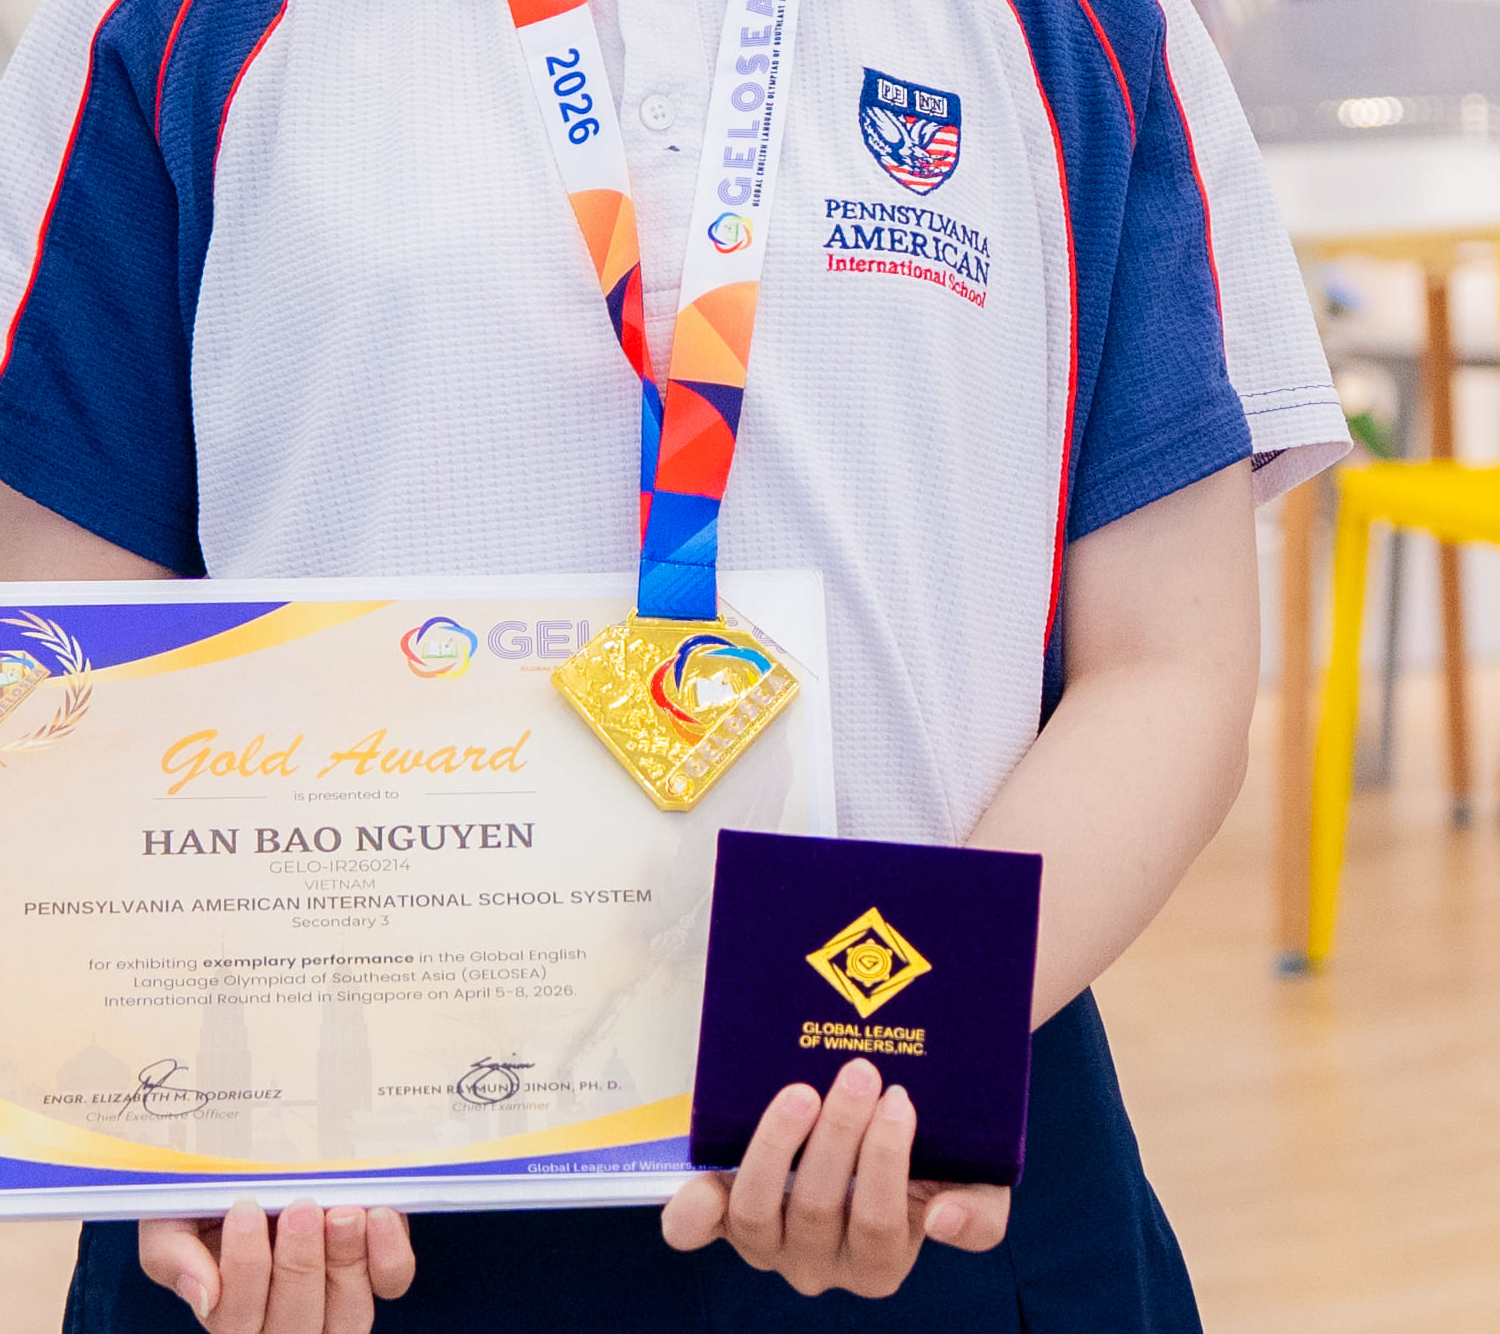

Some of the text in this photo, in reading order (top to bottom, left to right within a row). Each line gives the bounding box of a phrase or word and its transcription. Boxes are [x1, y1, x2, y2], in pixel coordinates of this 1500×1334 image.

[767, 60, 780, 99] OLYMPIAD
[544, 47, 601, 147] 2026
[761, 102, 774, 142] LANGUAGE
[756, 144, 769, 176] ENGLISH
[752, 179, 764, 207] GLOBAL
[825, 199, 991, 258] PENNSYLVANIA
[823, 223, 991, 287] AMERICAN
[826, 253, 987, 309] International School
[161, 728, 531, 795] Gold Award
[293, 789, 400, 803] is presented to
[142, 822, 535, 856] HAN BAO NGUYEN
[268, 858, 411, 874] GELO-IR260214
[304, 879, 376, 890] VIETNAM
[24, 889, 652, 916] PENNSYLVANIA AMERICAN INTERNATIONAL SCHOOL SYSTEM
[291, 915, 390, 930] Secondary 3
[89, 948, 587, 972] for exhibiting exemplary performance in the Global English
[133, 966, 548, 990] Language Olympiad of Southeast Asia (GELOSEA)
[104, 992, 213, 1008] International
[217, 991, 271, 1005] Round
[276, 990, 312, 1004] held
[317, 991, 332, 1003] in
[336, 988, 423, 1005] Singapore
[427, 989, 449, 1000] on
[454, 986, 491, 1002] April
[533, 984, 578, 997] 2026.
[799, 1035, 822, 1048] OF
[802, 1021, 926, 1041] GLOBAL LEAGUE
[43, 1093, 88, 1105] ENGR.
[173, 1090, 191, 1102] M.
[195, 1089, 283, 1101] RODRIGUEZ
[377, 1084, 442, 1096] STEPHEN
[523, 1081, 576, 1094] JINON,
[579, 1080, 603, 1091] PH.
[606, 1079, 623, 1090] D.
[192, 1108, 240, 1120] Officer
[527, 1162, 571, 1173] Global
[573, 1162, 621, 1174] League
[623, 1161, 637, 1172] of
